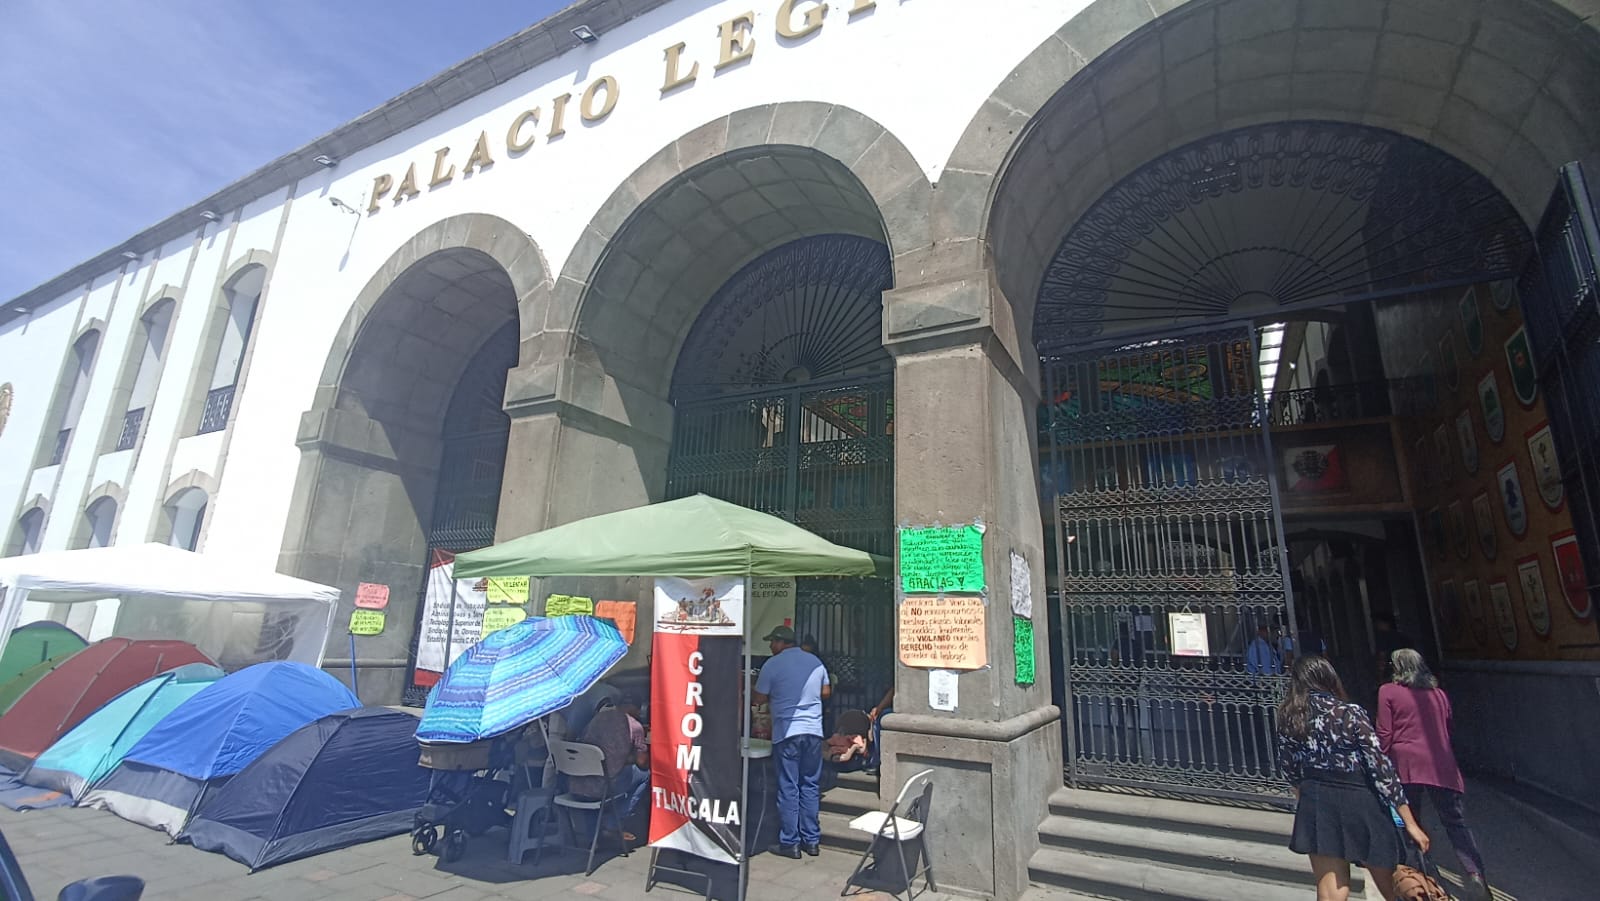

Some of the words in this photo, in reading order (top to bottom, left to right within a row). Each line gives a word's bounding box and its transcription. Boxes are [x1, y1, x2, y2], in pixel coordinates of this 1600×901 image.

[367, 75, 620, 213] PALACIO
[908, 577, 955, 590] GRACIAS
[911, 607, 922, 616] NO
[900, 642, 933, 651] DERECHO
[676, 651, 704, 771] CROM
[652, 786, 741, 826] TLAXCALA
